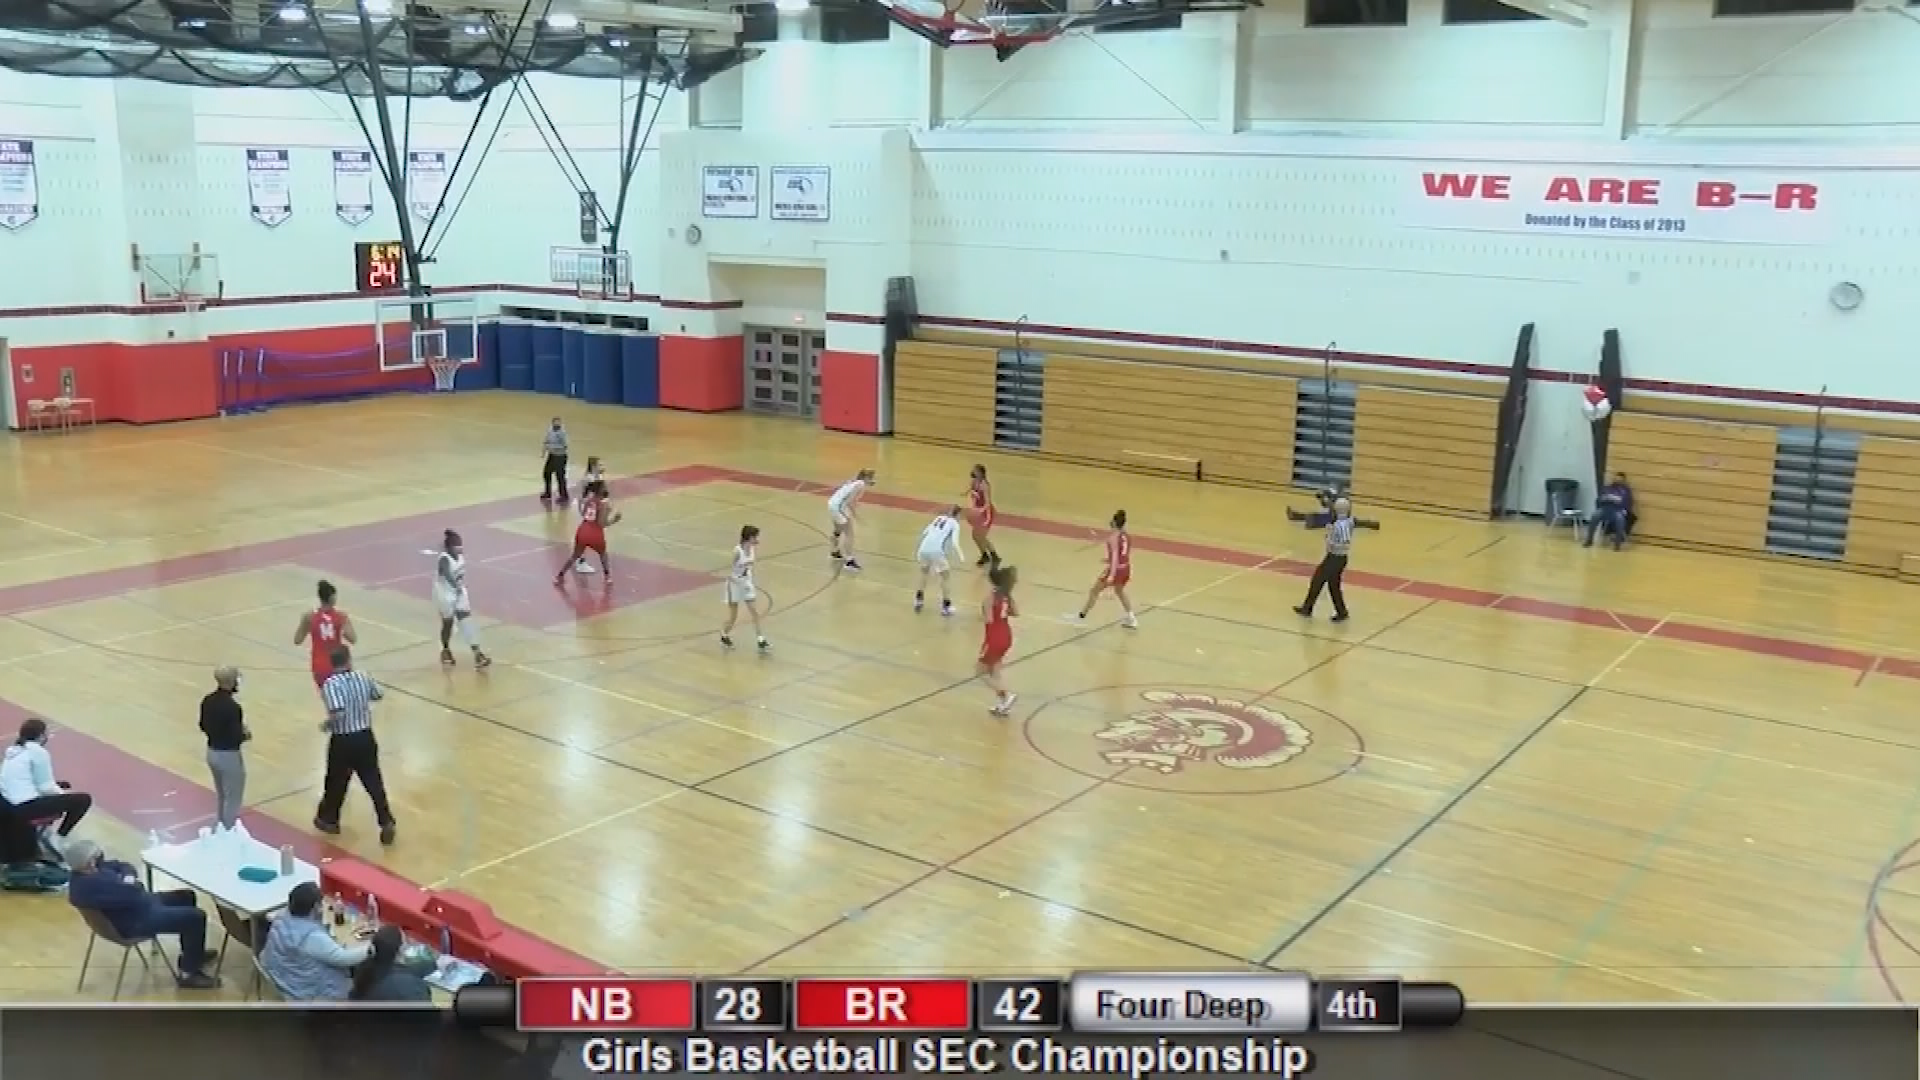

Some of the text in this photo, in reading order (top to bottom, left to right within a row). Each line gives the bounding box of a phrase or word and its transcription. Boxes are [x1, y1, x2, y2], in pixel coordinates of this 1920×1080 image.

[1422, 172, 1818, 210] WE ARE B-R
[1525, 213, 1686, 233] Donated by the Class of 2013
[370, 261, 396, 287] 24
